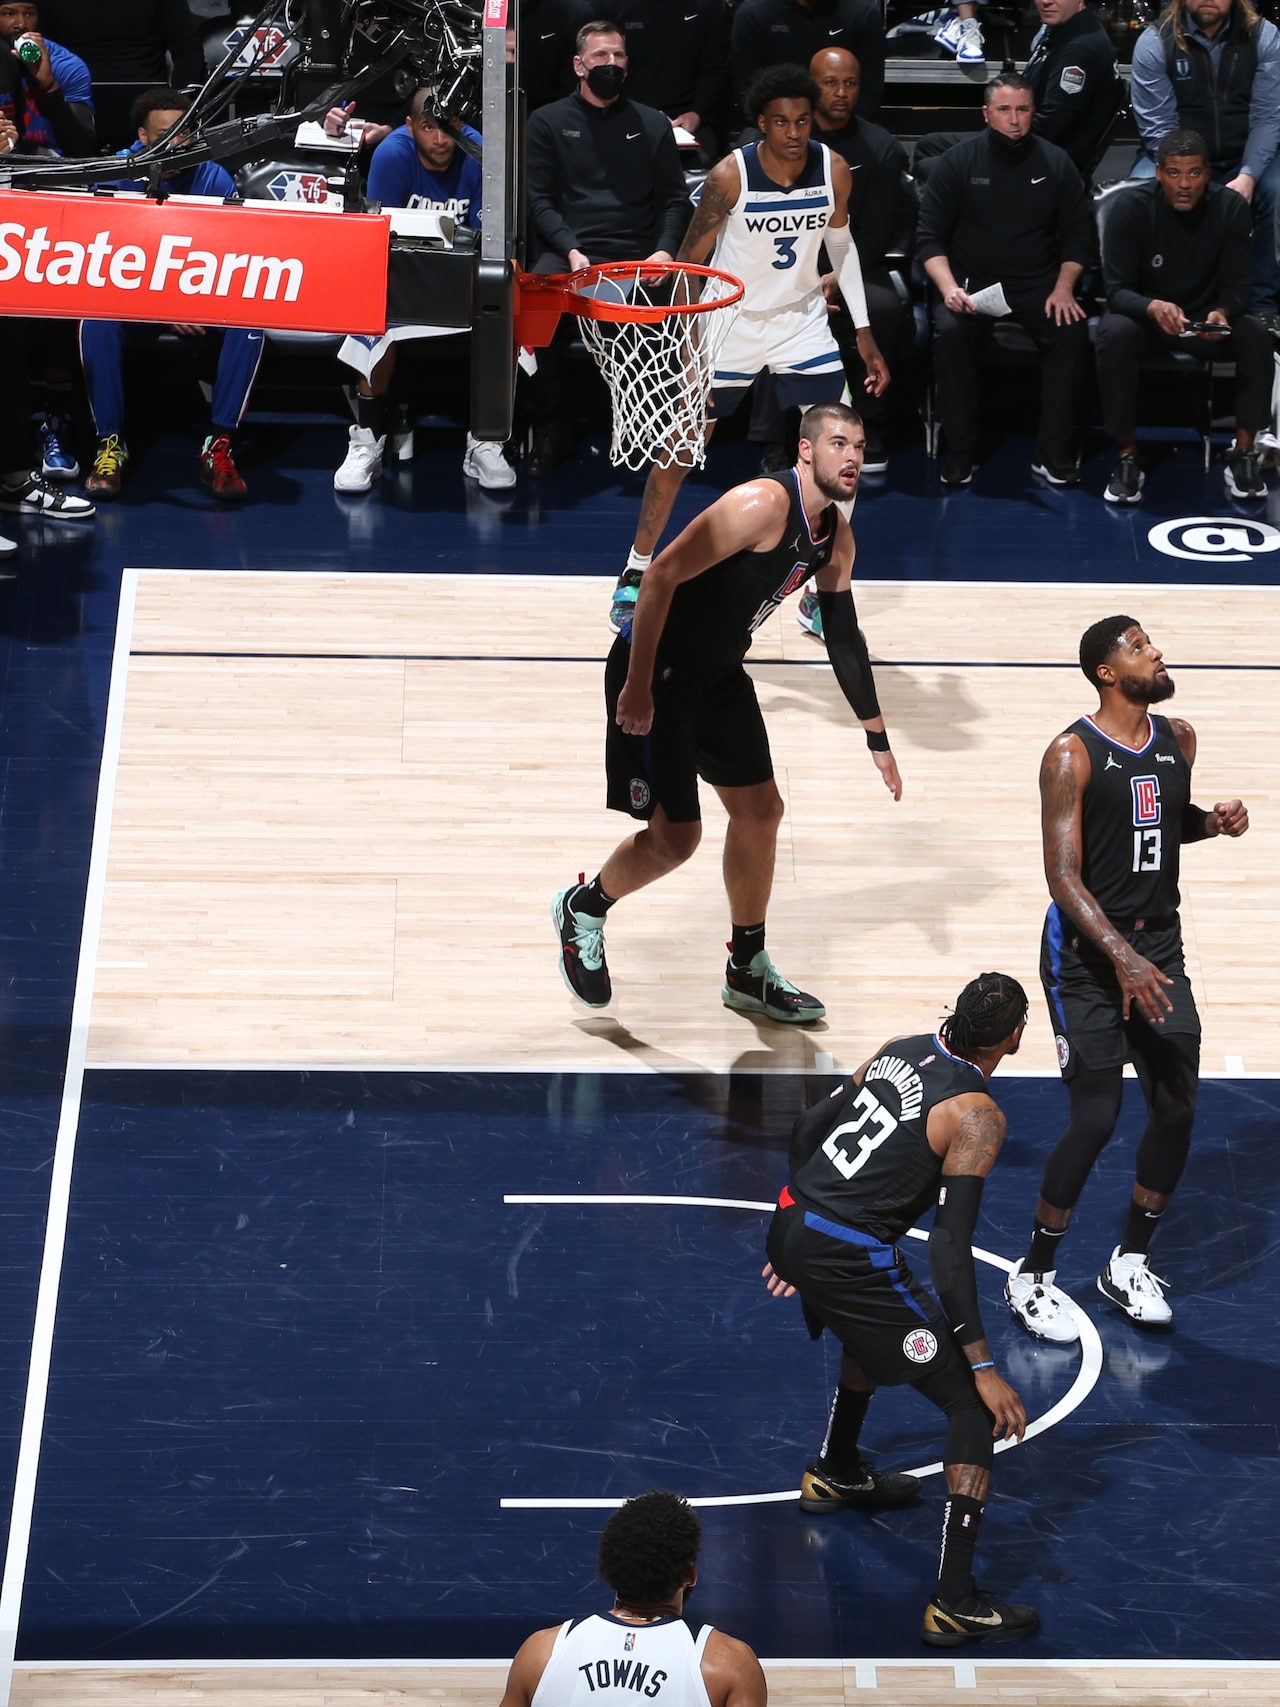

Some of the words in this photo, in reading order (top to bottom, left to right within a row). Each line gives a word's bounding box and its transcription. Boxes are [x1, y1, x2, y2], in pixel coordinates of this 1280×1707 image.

[307, 181, 321, 201] 75
[745, 212, 827, 233] WOLVES
[771, 236, 799, 270] 3
[1132, 828, 1162, 873] 13
[865, 1055, 925, 1122] COVINGTON
[821, 1086, 898, 1181] 23
[578, 1658, 668, 1698] TOWNS
